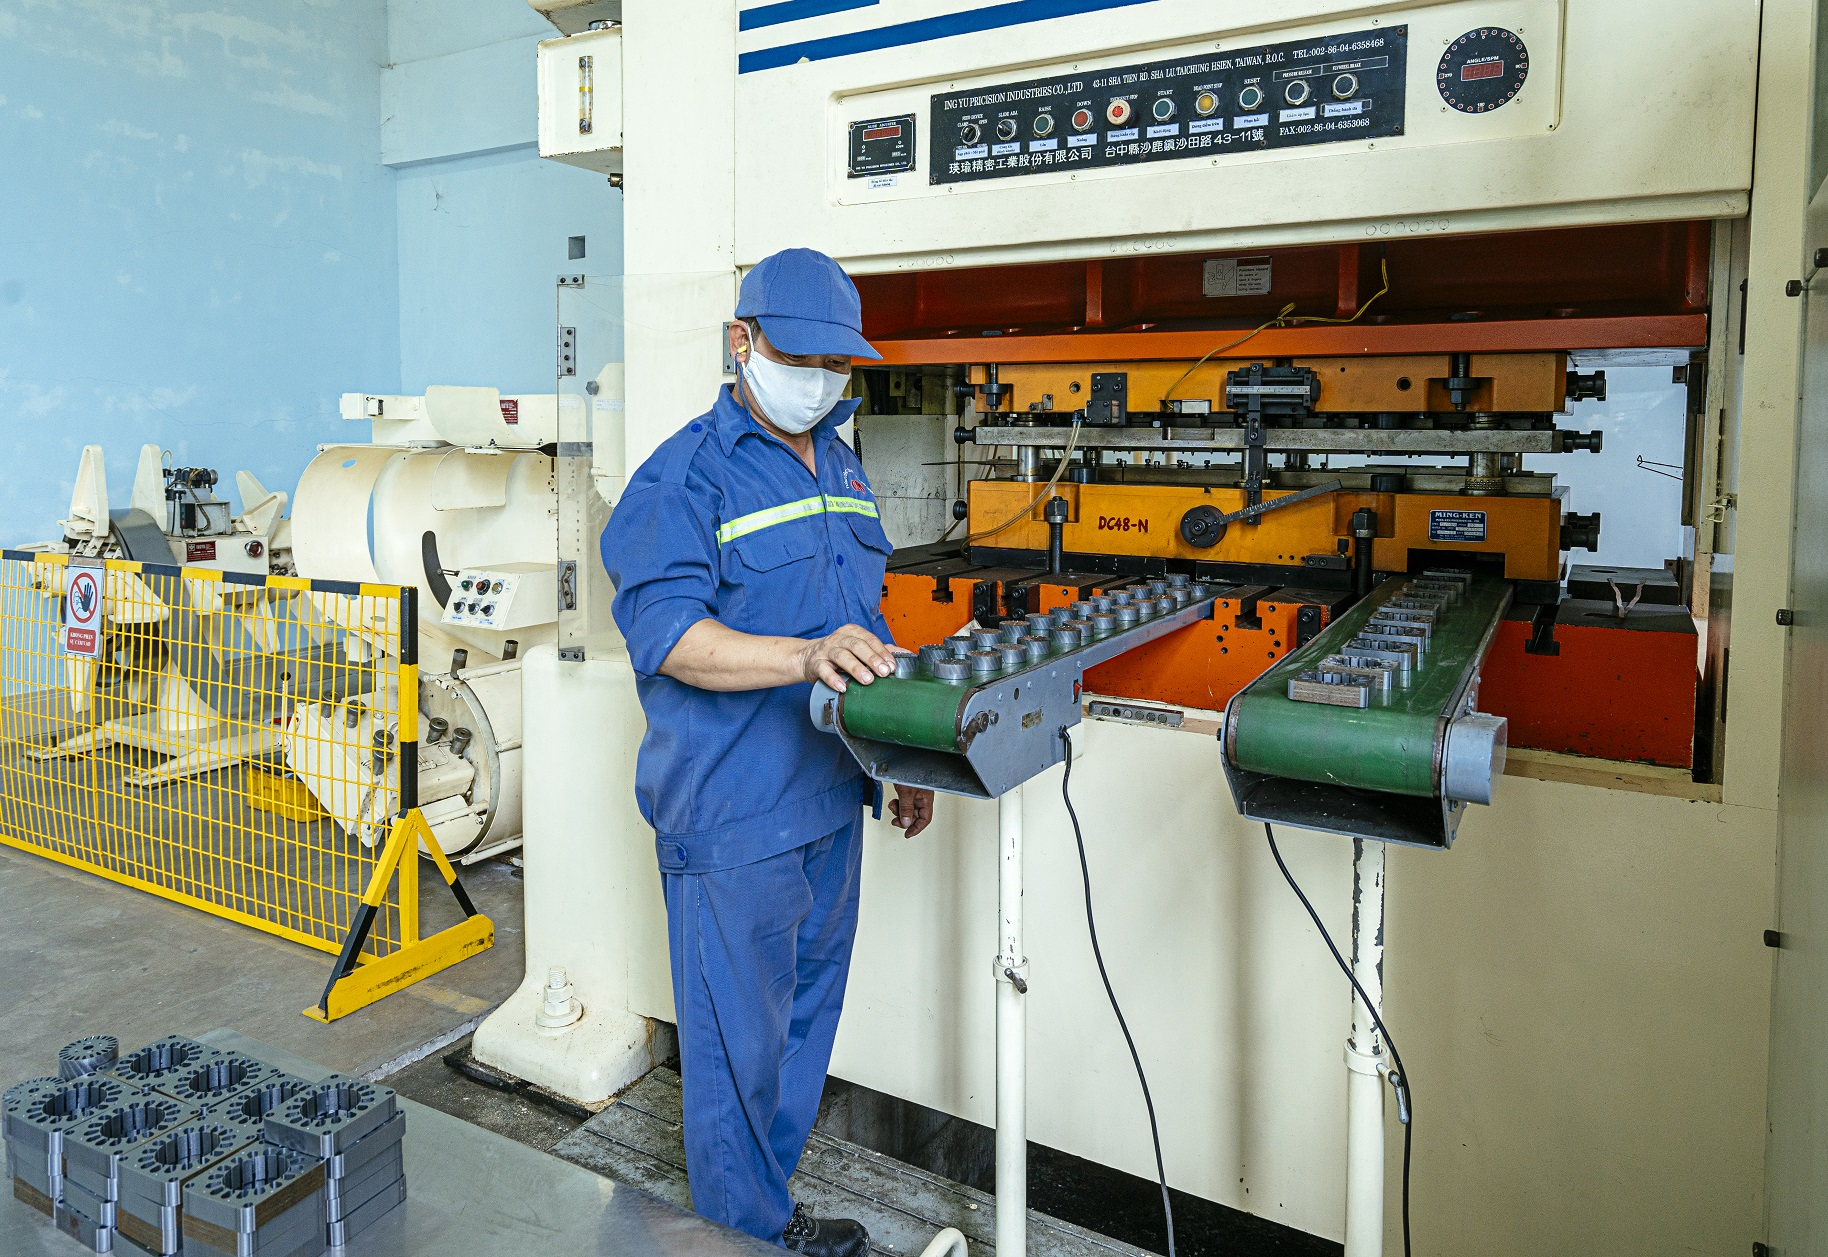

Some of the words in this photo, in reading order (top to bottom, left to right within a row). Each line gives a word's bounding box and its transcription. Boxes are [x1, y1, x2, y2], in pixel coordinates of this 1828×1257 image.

[1092, 78, 1108, 88] 43-11
[1108, 75, 1121, 86] SHA
[1123, 73, 1138, 84] TIEN
[1150, 69, 1164, 80] SHA
[1211, 59, 1234, 71] HSIEN,
[1235, 55, 1264, 68] TAIWAN,
[944, 99, 958, 111] ING
[958, 97, 969, 109] YU
[969, 92, 1006, 107] PRICISION
[1006, 85, 1053, 102] INDUSTRIES
[1098, 515, 1149, 533] DC48-N
[1435, 511, 1481, 519] MING-KEN
